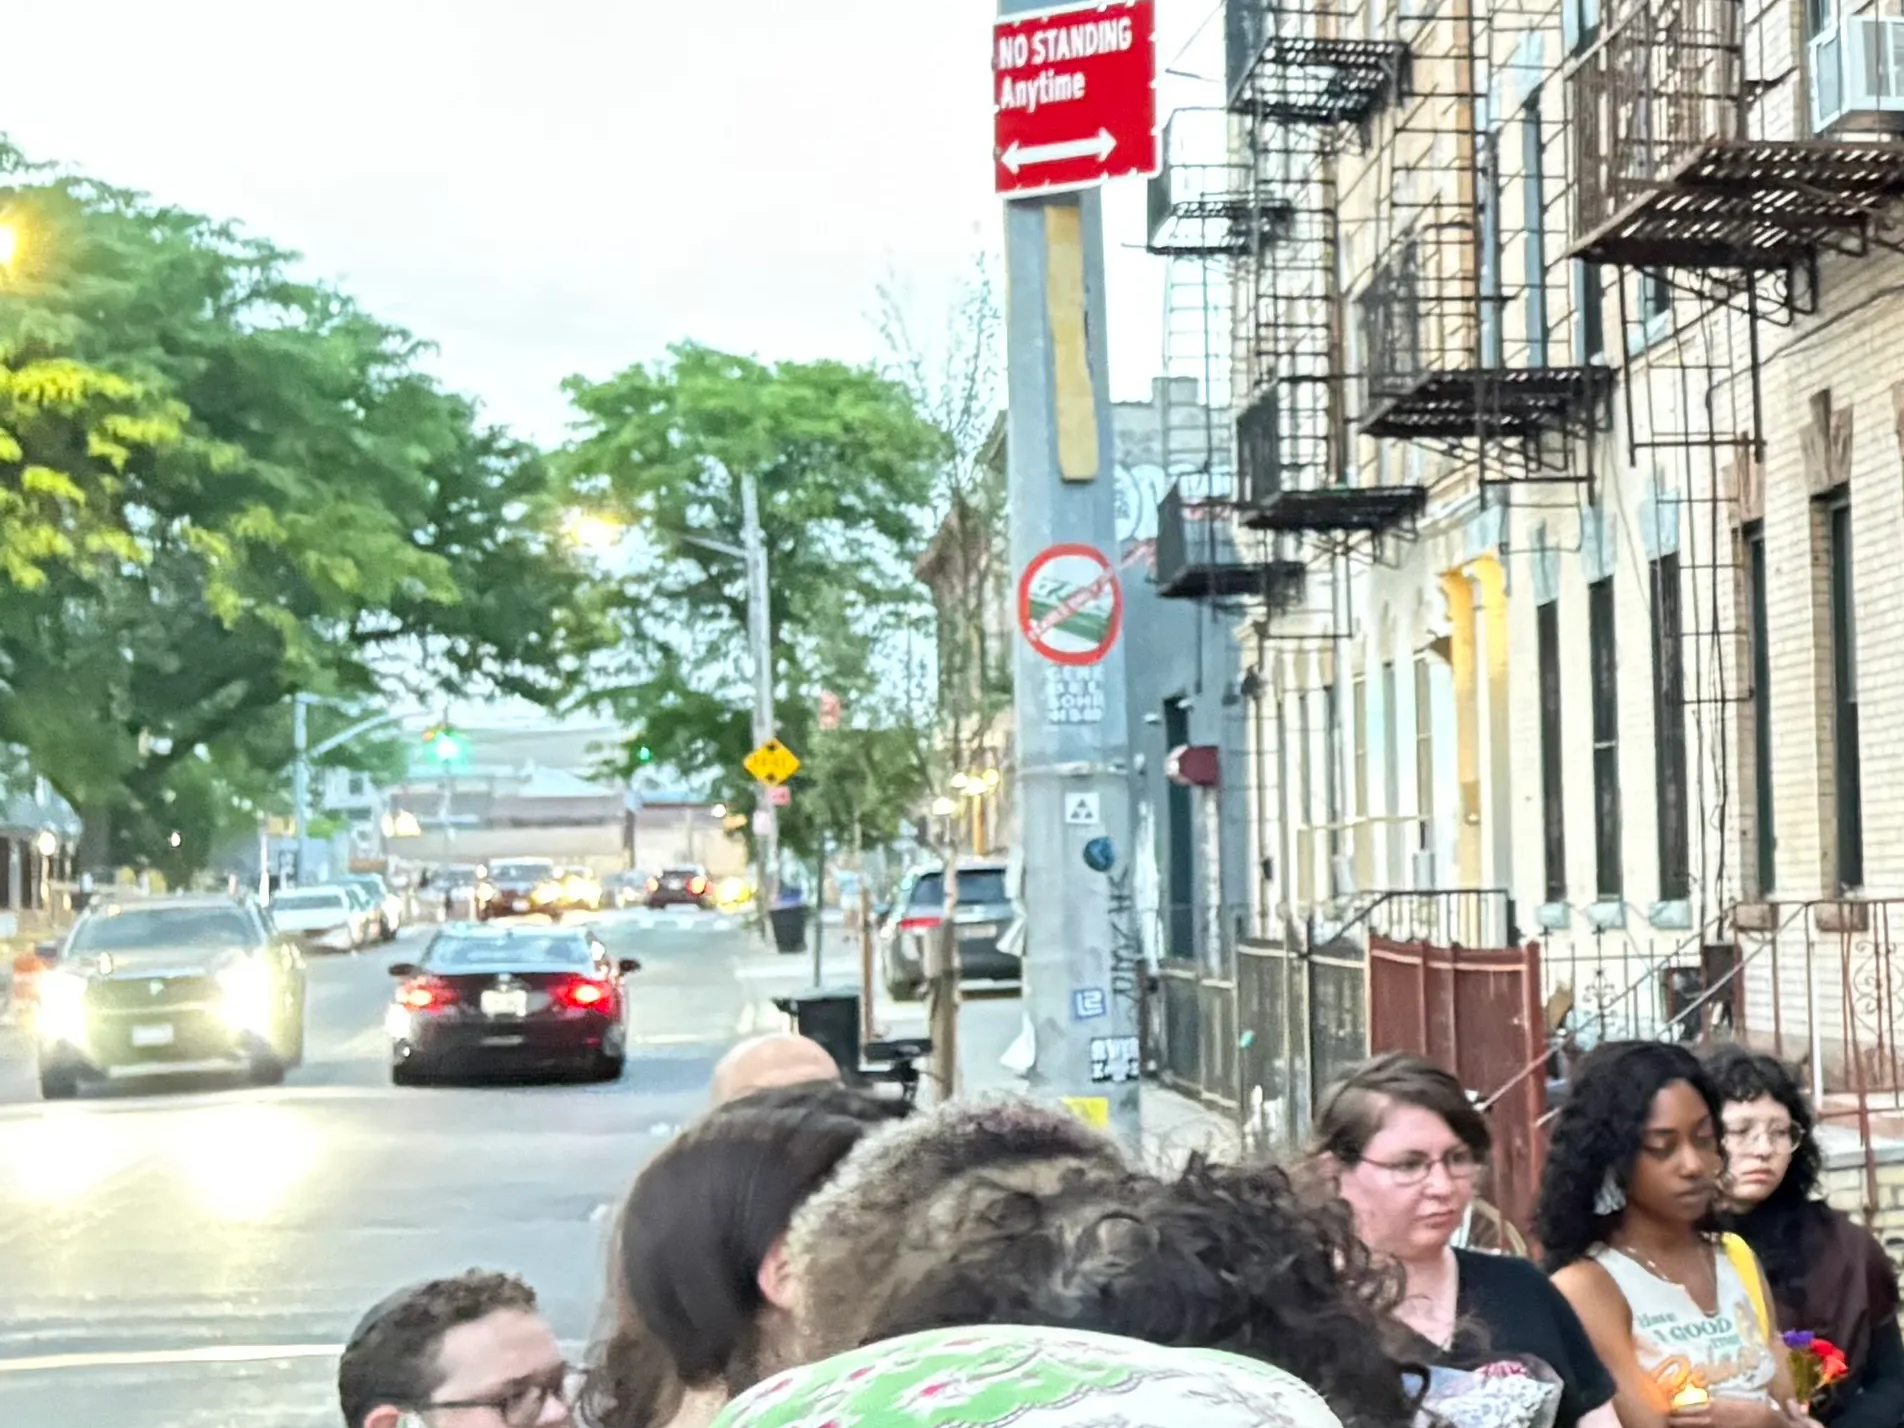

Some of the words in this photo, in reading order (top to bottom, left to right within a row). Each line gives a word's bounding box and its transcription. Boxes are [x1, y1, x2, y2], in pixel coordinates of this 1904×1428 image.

[999, 33, 1029, 69] NO
[1031, 17, 1133, 65] STANDING
[1001, 68, 1086, 113] Anytime
[1669, 1317, 1733, 1342] GOOD
